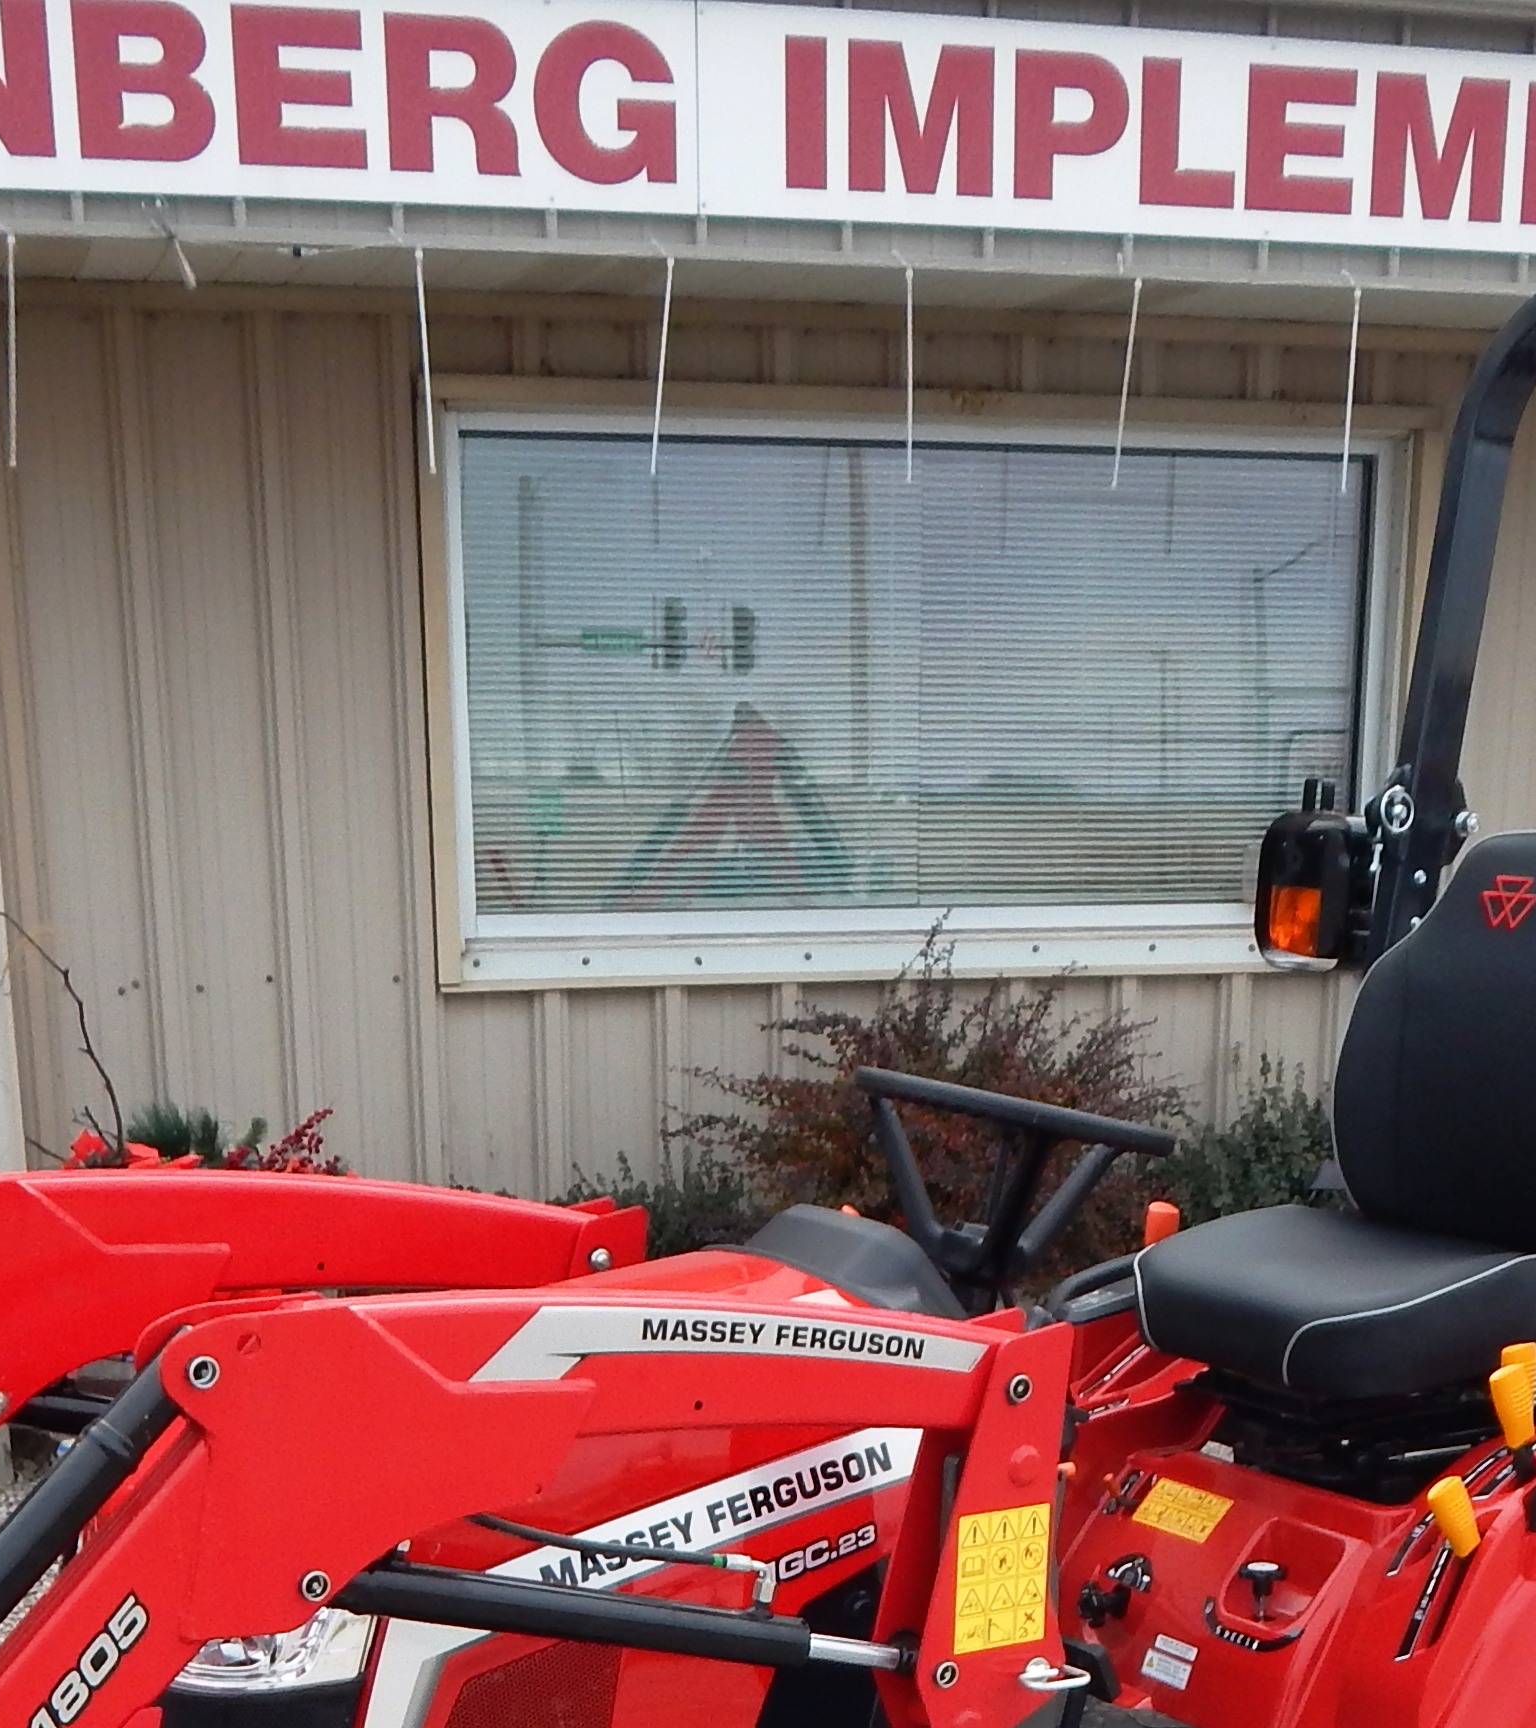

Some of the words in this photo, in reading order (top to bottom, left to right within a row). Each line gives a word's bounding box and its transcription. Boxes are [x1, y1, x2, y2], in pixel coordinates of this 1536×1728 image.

[641, 1318, 766, 1345] MASSEY
[775, 1324, 926, 1360] FERGUSON
[706, 1442, 893, 1534] FERGUSON
